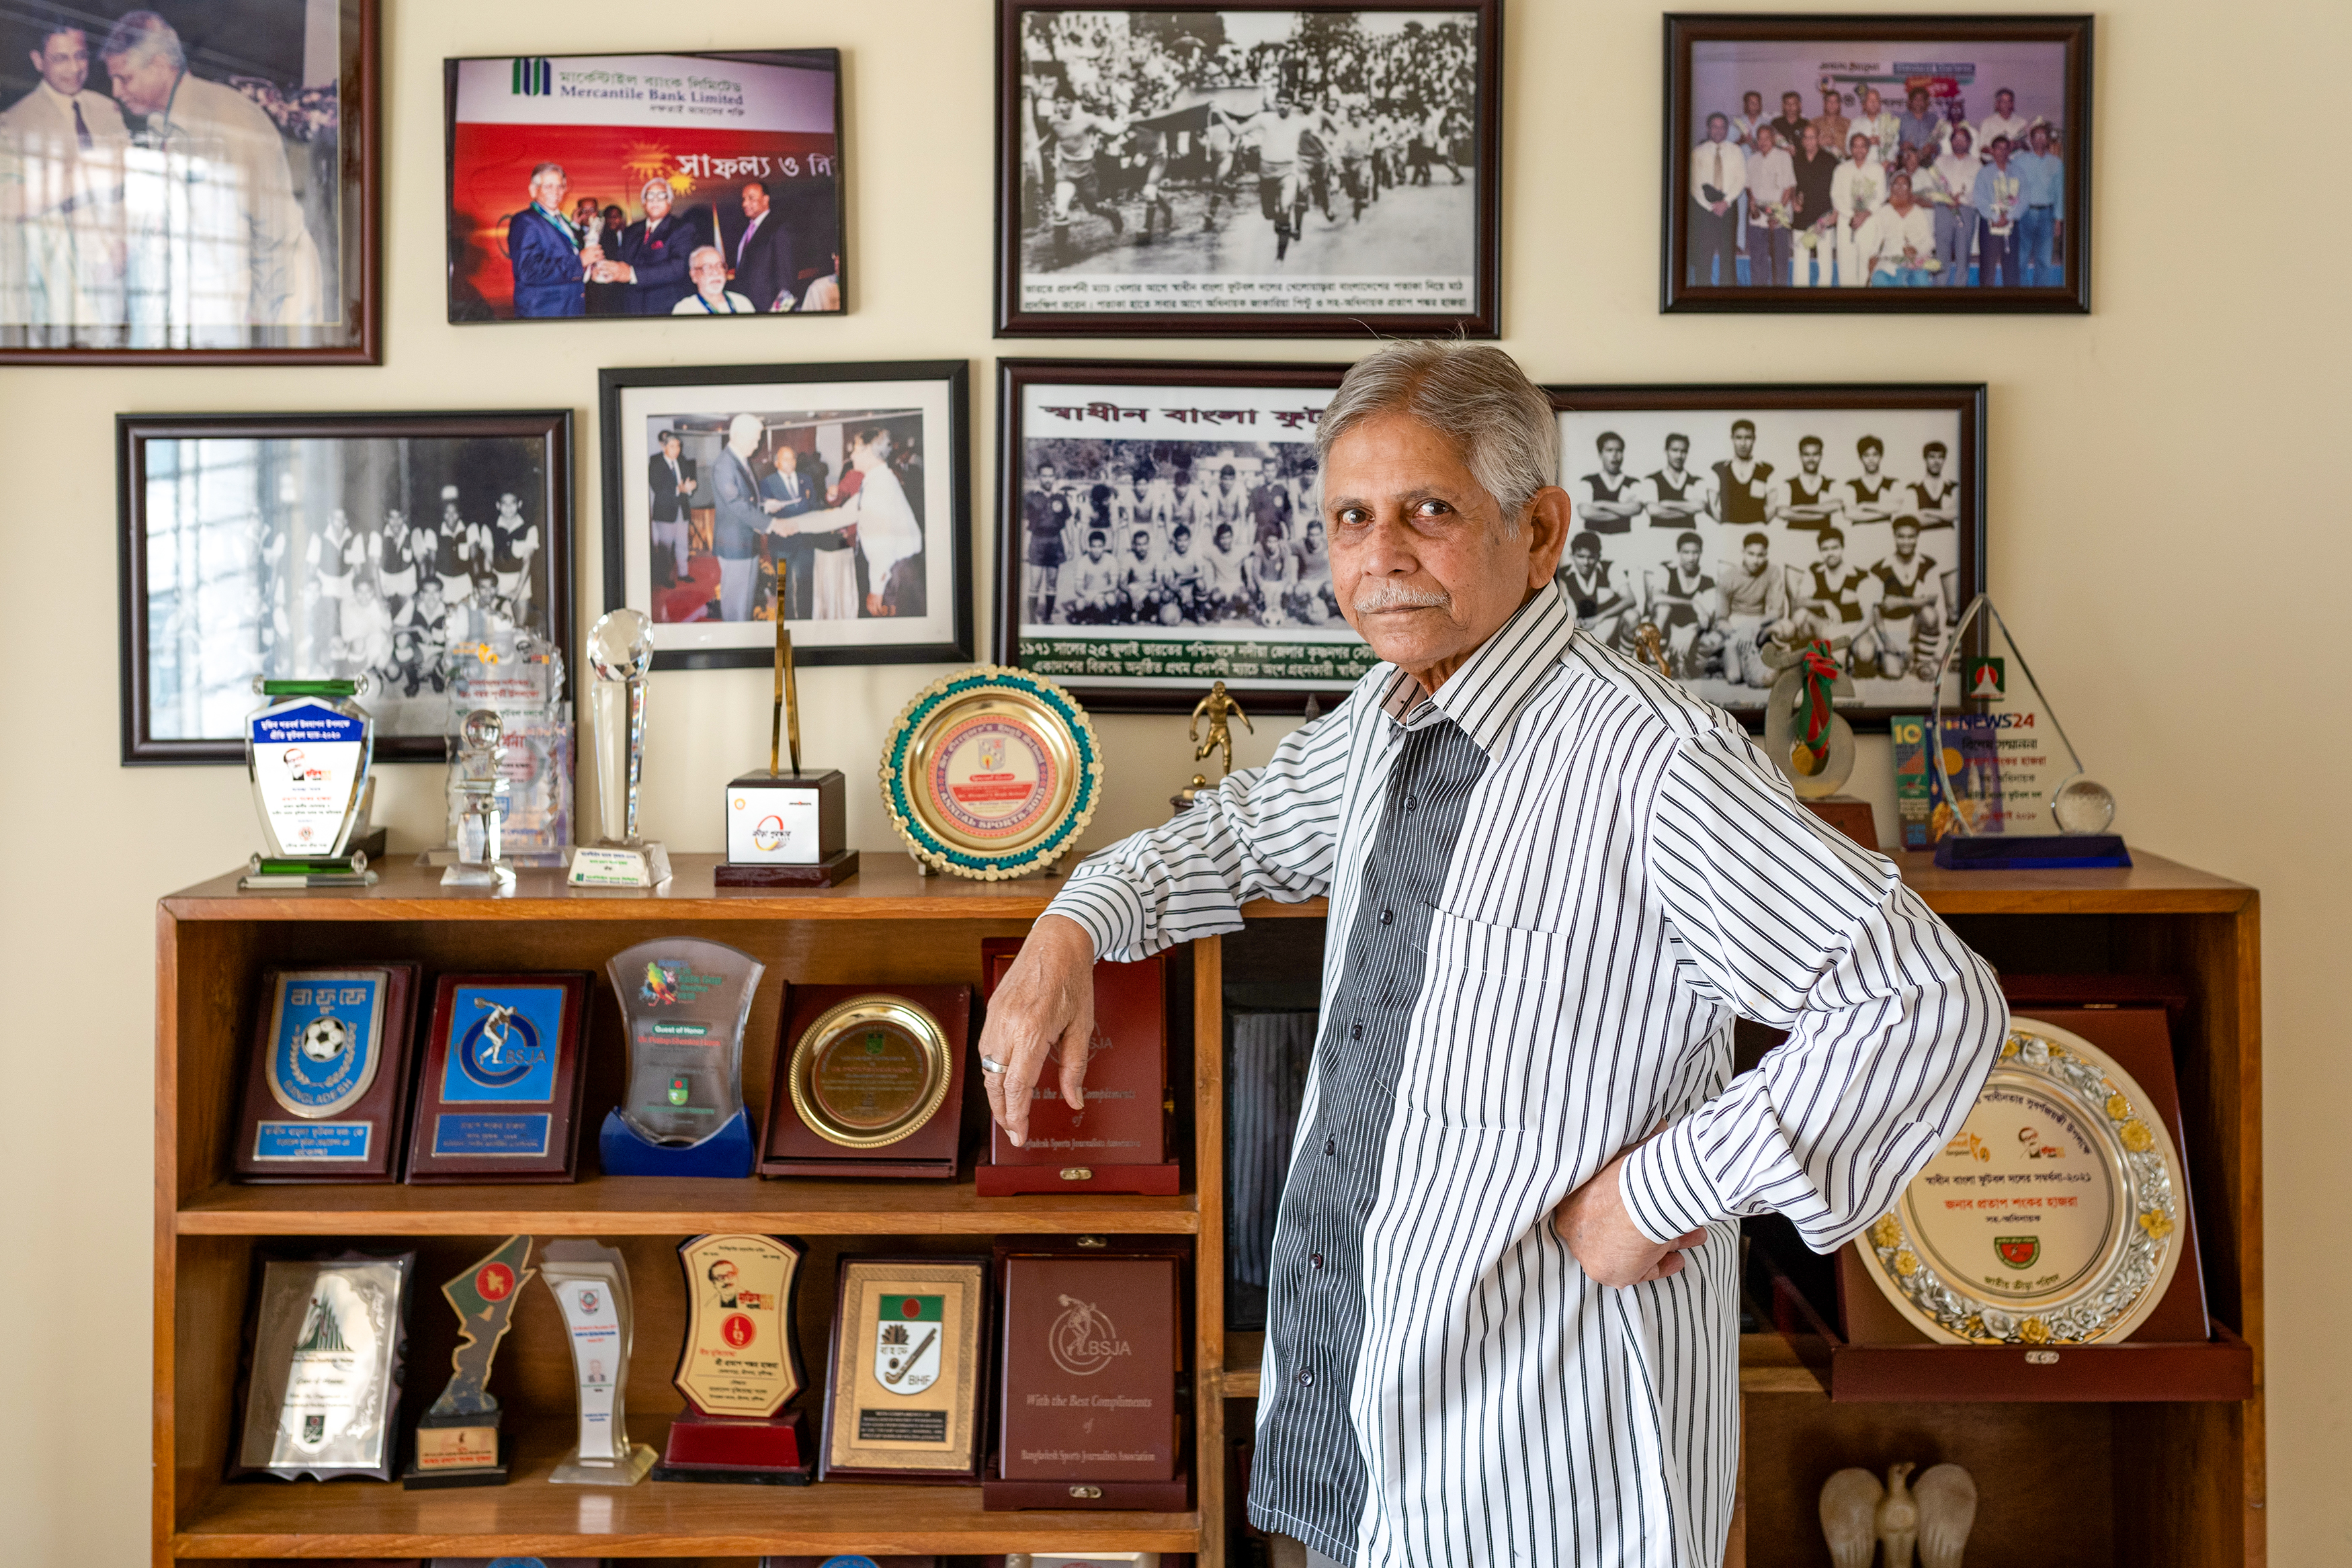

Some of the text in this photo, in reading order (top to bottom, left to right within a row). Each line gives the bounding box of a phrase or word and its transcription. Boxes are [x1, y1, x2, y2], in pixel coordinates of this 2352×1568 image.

[560, 85, 744, 105] Mercantile Bank Limited
[675, 153, 835, 179] সাফল্য ও নি
[1039, 402, 1150, 423] স্বাধীন
[1161, 407, 1259, 425] বাংলা
[1019, 642, 1050, 656] ১৯৭১
[1960, 713, 2035, 730] NEWS24
[1894, 724, 1922, 744] 10
[655, 1025, 706, 1035] Guest of Honor
[1088, 1037, 1114, 1049] SJA
[505, 1049, 548, 1064] BSJA
[1925, 1173, 2032, 1187] স্বাধীন বাংলা ফুটবল দলের
[1944, 1196, 2079, 1210] জনাব প্রতাপ শংকর হাজরা
[1087, 1340, 1132, 1356] BSJA
[909, 1375, 931, 1385] BHF
[1026, 1394, 1050, 1407] With
[1052, 1394, 1068, 1407] the
[1068, 1394, 1089, 1407] Best
